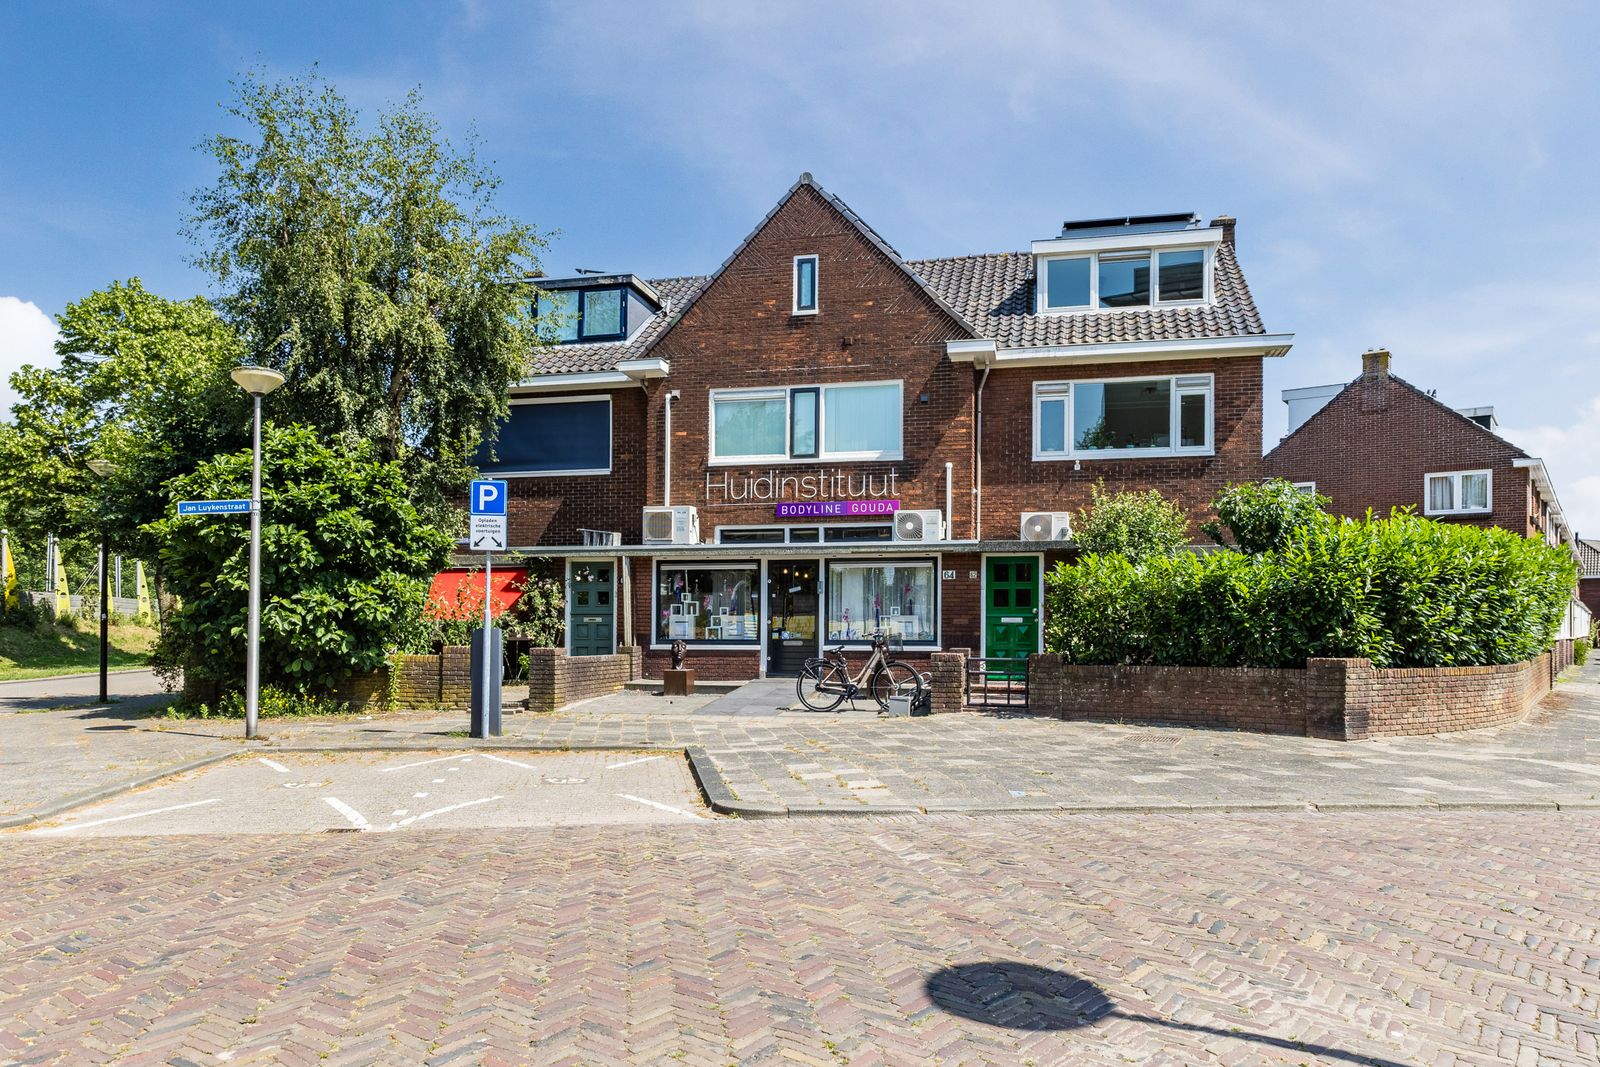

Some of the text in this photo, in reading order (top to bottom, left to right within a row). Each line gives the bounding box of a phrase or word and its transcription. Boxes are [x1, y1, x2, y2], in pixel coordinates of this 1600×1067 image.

[706, 467, 900, 500] Huidinstituut
[479, 485, 498, 511] P
[198, 503, 246, 513] Luykenstraat
[781, 502, 894, 515] BODYLINE GOUDA
